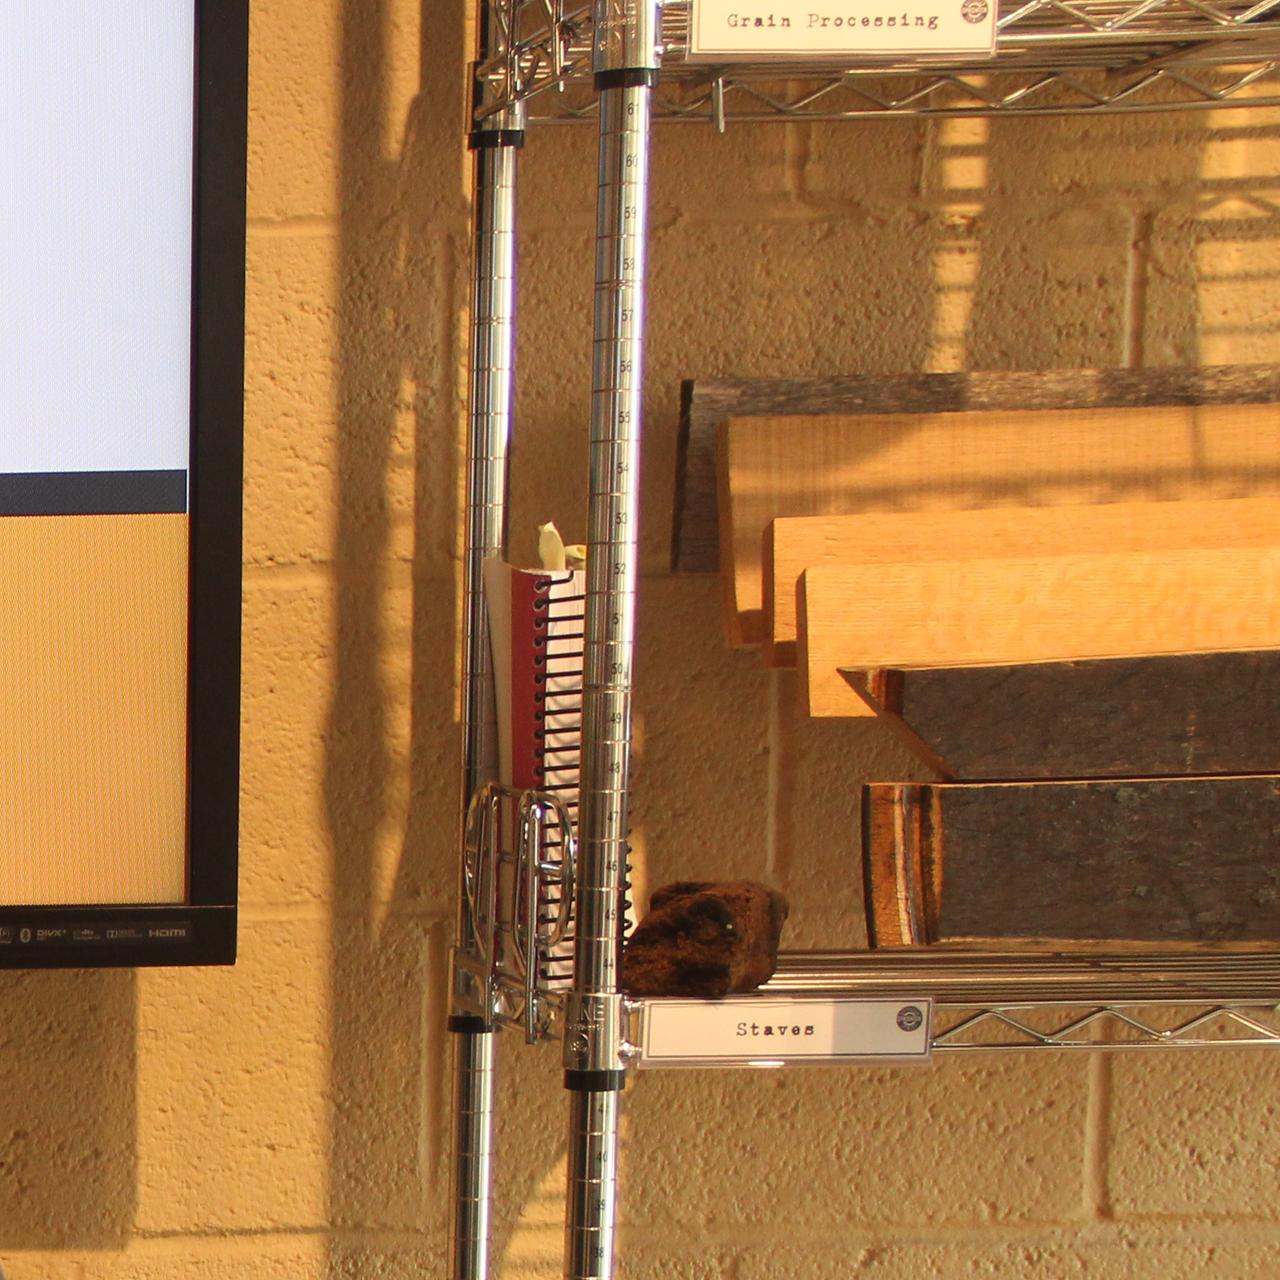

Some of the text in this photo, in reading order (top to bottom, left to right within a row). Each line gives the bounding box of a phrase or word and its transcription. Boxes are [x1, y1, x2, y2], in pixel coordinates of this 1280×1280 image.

[727, 13, 940, 30] Grain Processing
[736, 1022, 815, 1037] Staves
